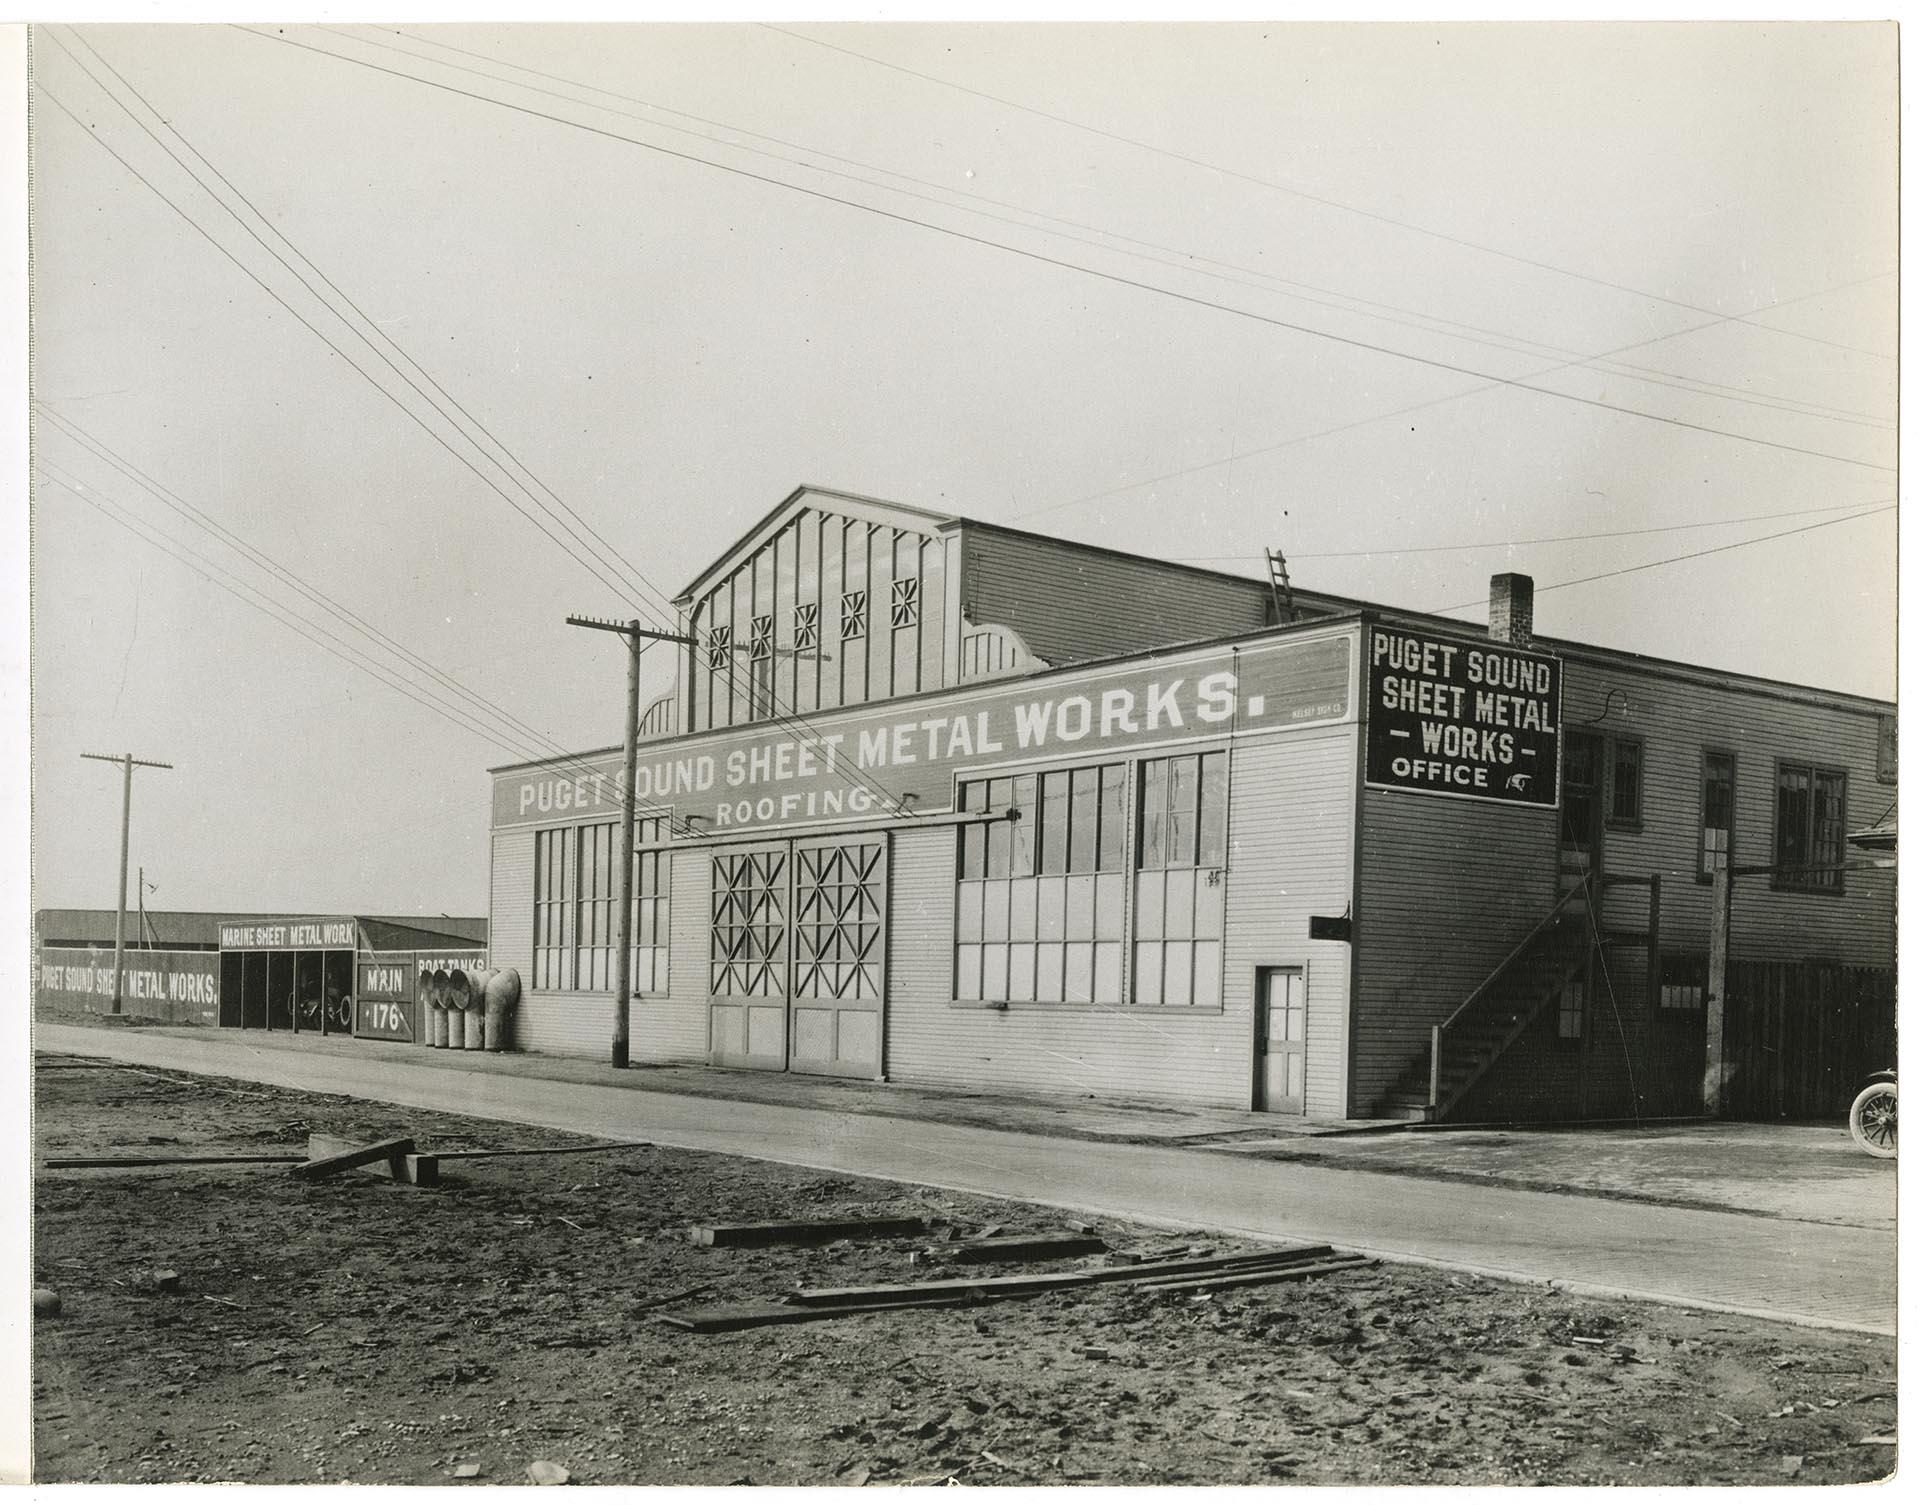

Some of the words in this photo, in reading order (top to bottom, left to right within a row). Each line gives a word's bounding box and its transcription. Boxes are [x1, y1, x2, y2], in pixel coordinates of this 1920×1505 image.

[1373, 633, 1458, 678] PUGET
[1467, 650, 1550, 694] SOUND
[1382, 675, 1465, 719] SHEET
[1475, 690, 1555, 733] METAL
[519, 772, 606, 816] PUGET
[726, 734, 843, 787] SHEET
[858, 711, 1003, 769] METAL
[1014, 671, 1265, 749] WORKS.
[1421, 720, 1514, 764] WORKS
[1391, 757, 1489, 787] OFFICE
[222, 927, 255, 947] MARINE
[256, 926, 286, 946] SHEET
[290, 924, 322, 946] METAL
[323, 922, 353, 945] WORK
[41, 964, 64, 991] PUGET
[65, 965, 93, 993] SOUND
[96, 967, 126, 996] SHET
[129, 969, 166, 999] METAL
[169, 972, 218, 1005] WORKS.
[367, 968, 403, 993] MAIN
